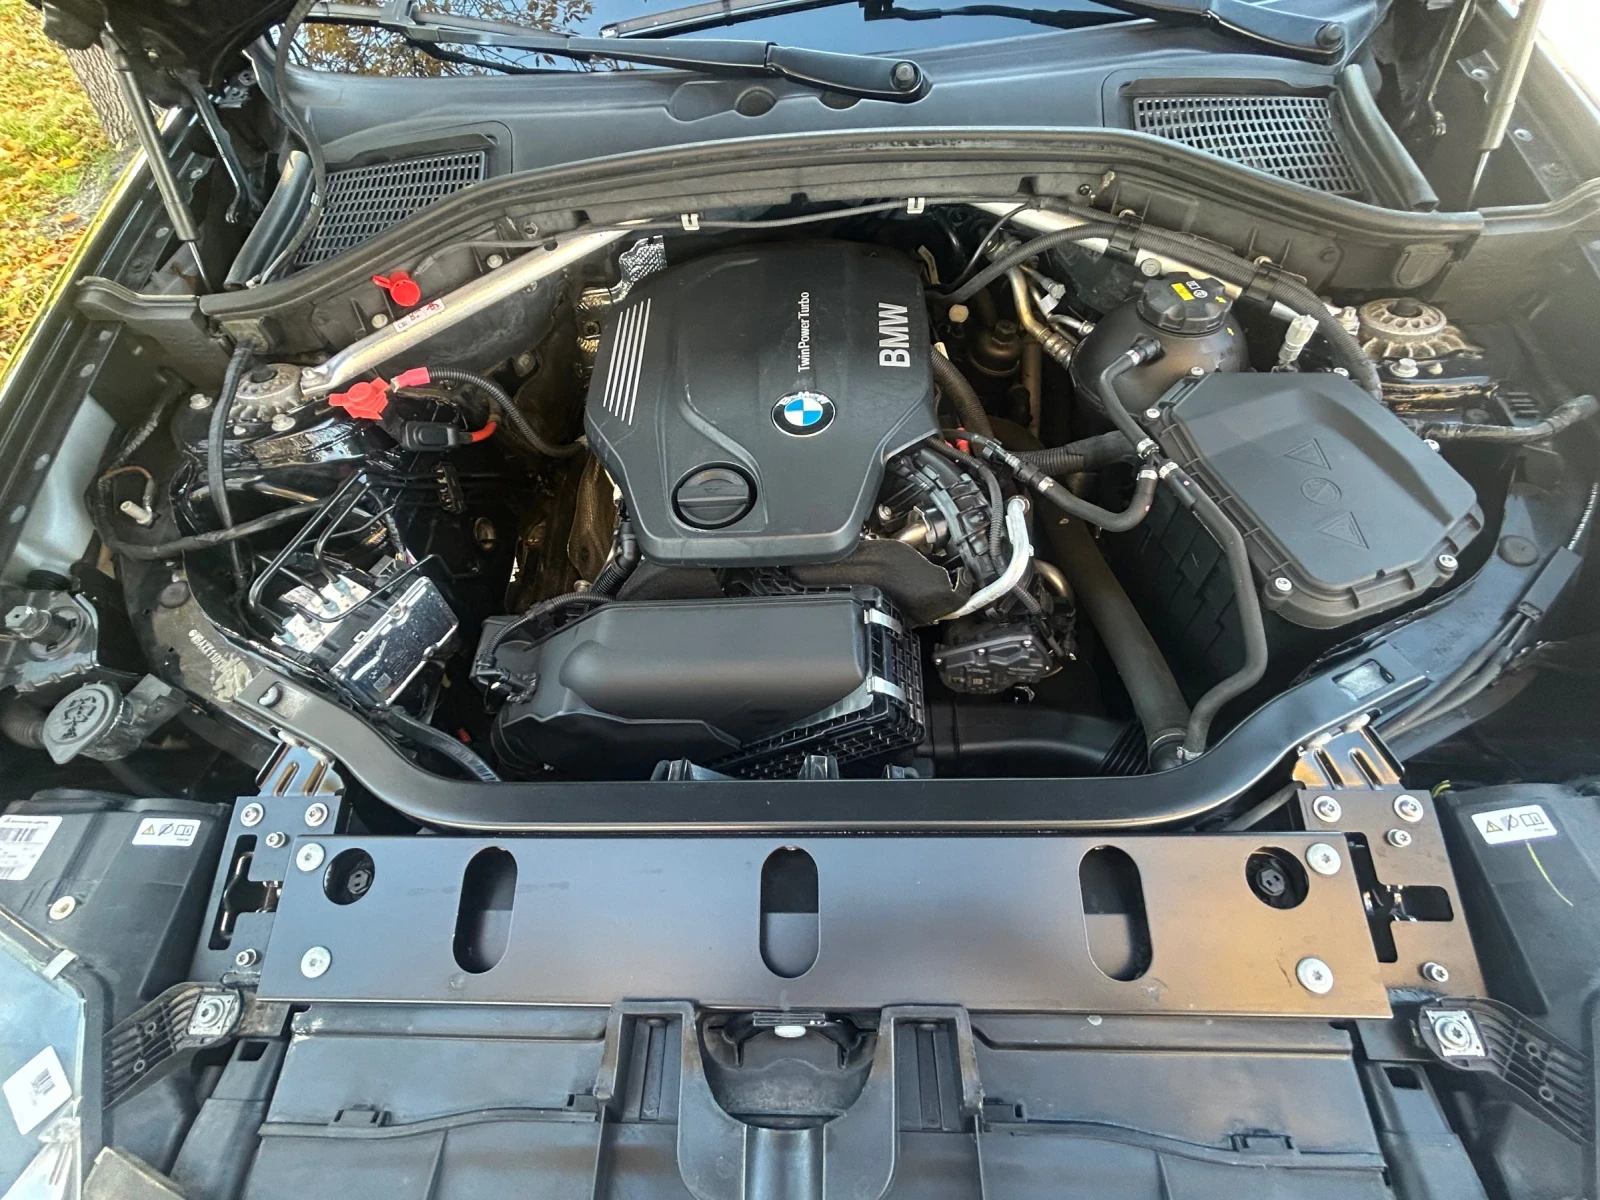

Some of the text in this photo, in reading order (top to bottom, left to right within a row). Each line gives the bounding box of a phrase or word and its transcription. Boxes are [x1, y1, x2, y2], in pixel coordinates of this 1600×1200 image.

[798, 291, 810, 373] TwinPower Turbo
[878, 302, 911, 367] BMW
